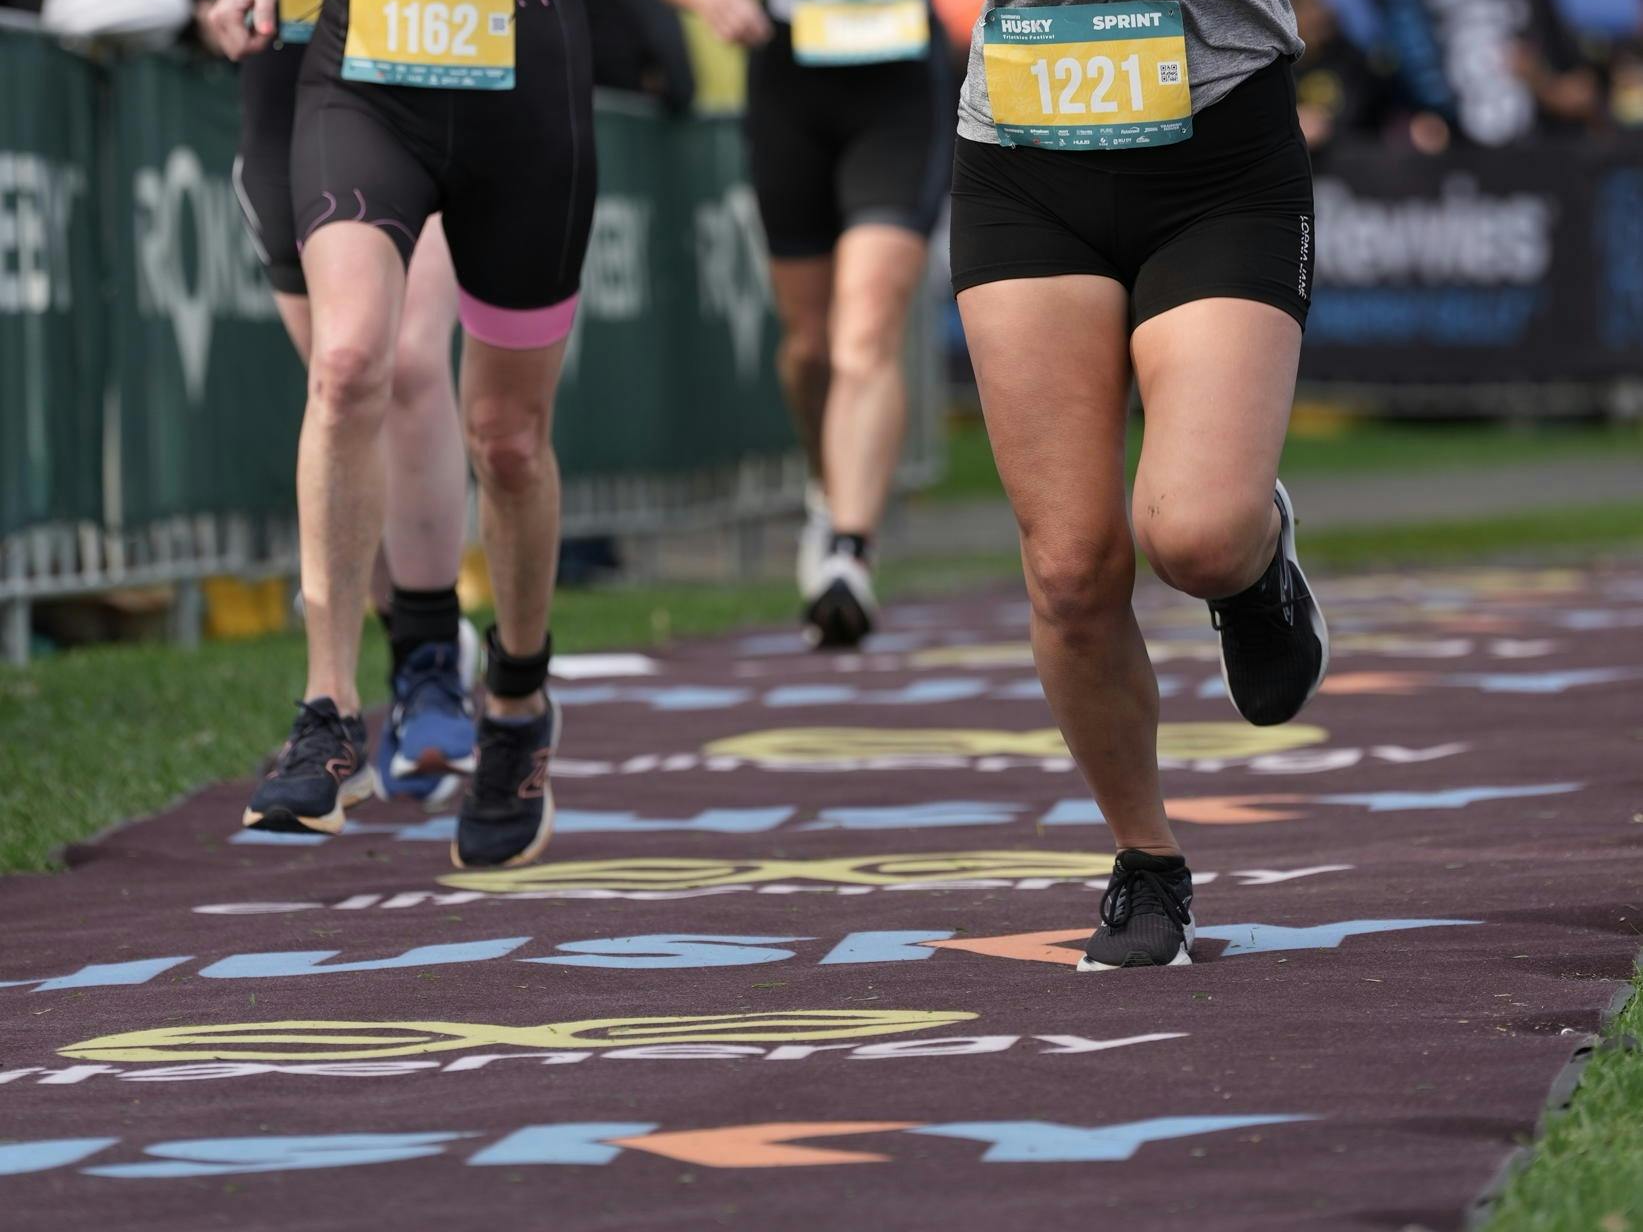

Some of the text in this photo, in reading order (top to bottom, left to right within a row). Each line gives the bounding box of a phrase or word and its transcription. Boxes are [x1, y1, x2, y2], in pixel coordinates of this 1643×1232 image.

[383, 0, 478, 56] 1162
[1001, 12, 1162, 33] HUSKY SPRINT
[1031, 54, 1143, 114] 1221
